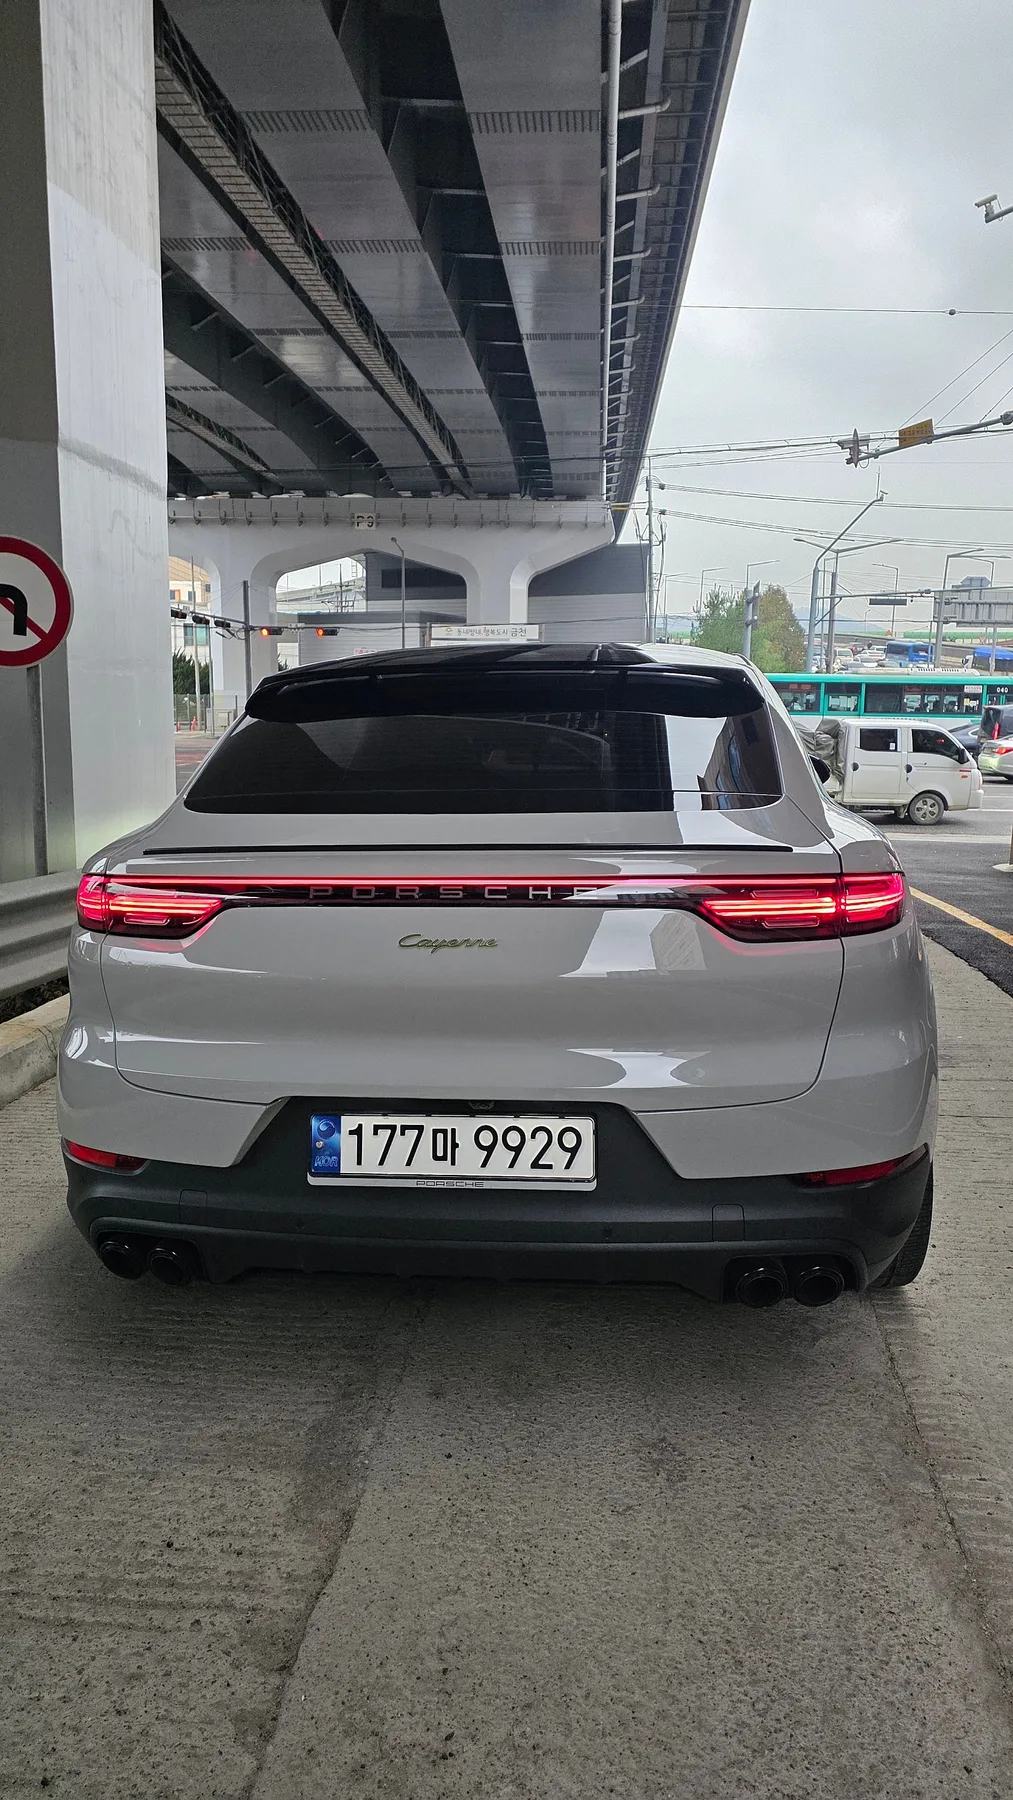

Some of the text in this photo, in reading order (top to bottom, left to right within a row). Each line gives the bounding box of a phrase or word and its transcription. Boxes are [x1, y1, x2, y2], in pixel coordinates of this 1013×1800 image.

[483, 626, 508, 637] 행복도시
[510, 627, 527, 637] 금천
[309, 886, 598, 900] PORSCHE
[398, 933, 498, 954] Cayenne
[347, 1123, 583, 1170] 177마 9929
[314, 1155, 339, 1167] KOR
[416, 1180, 484, 1188] PORSCHE
